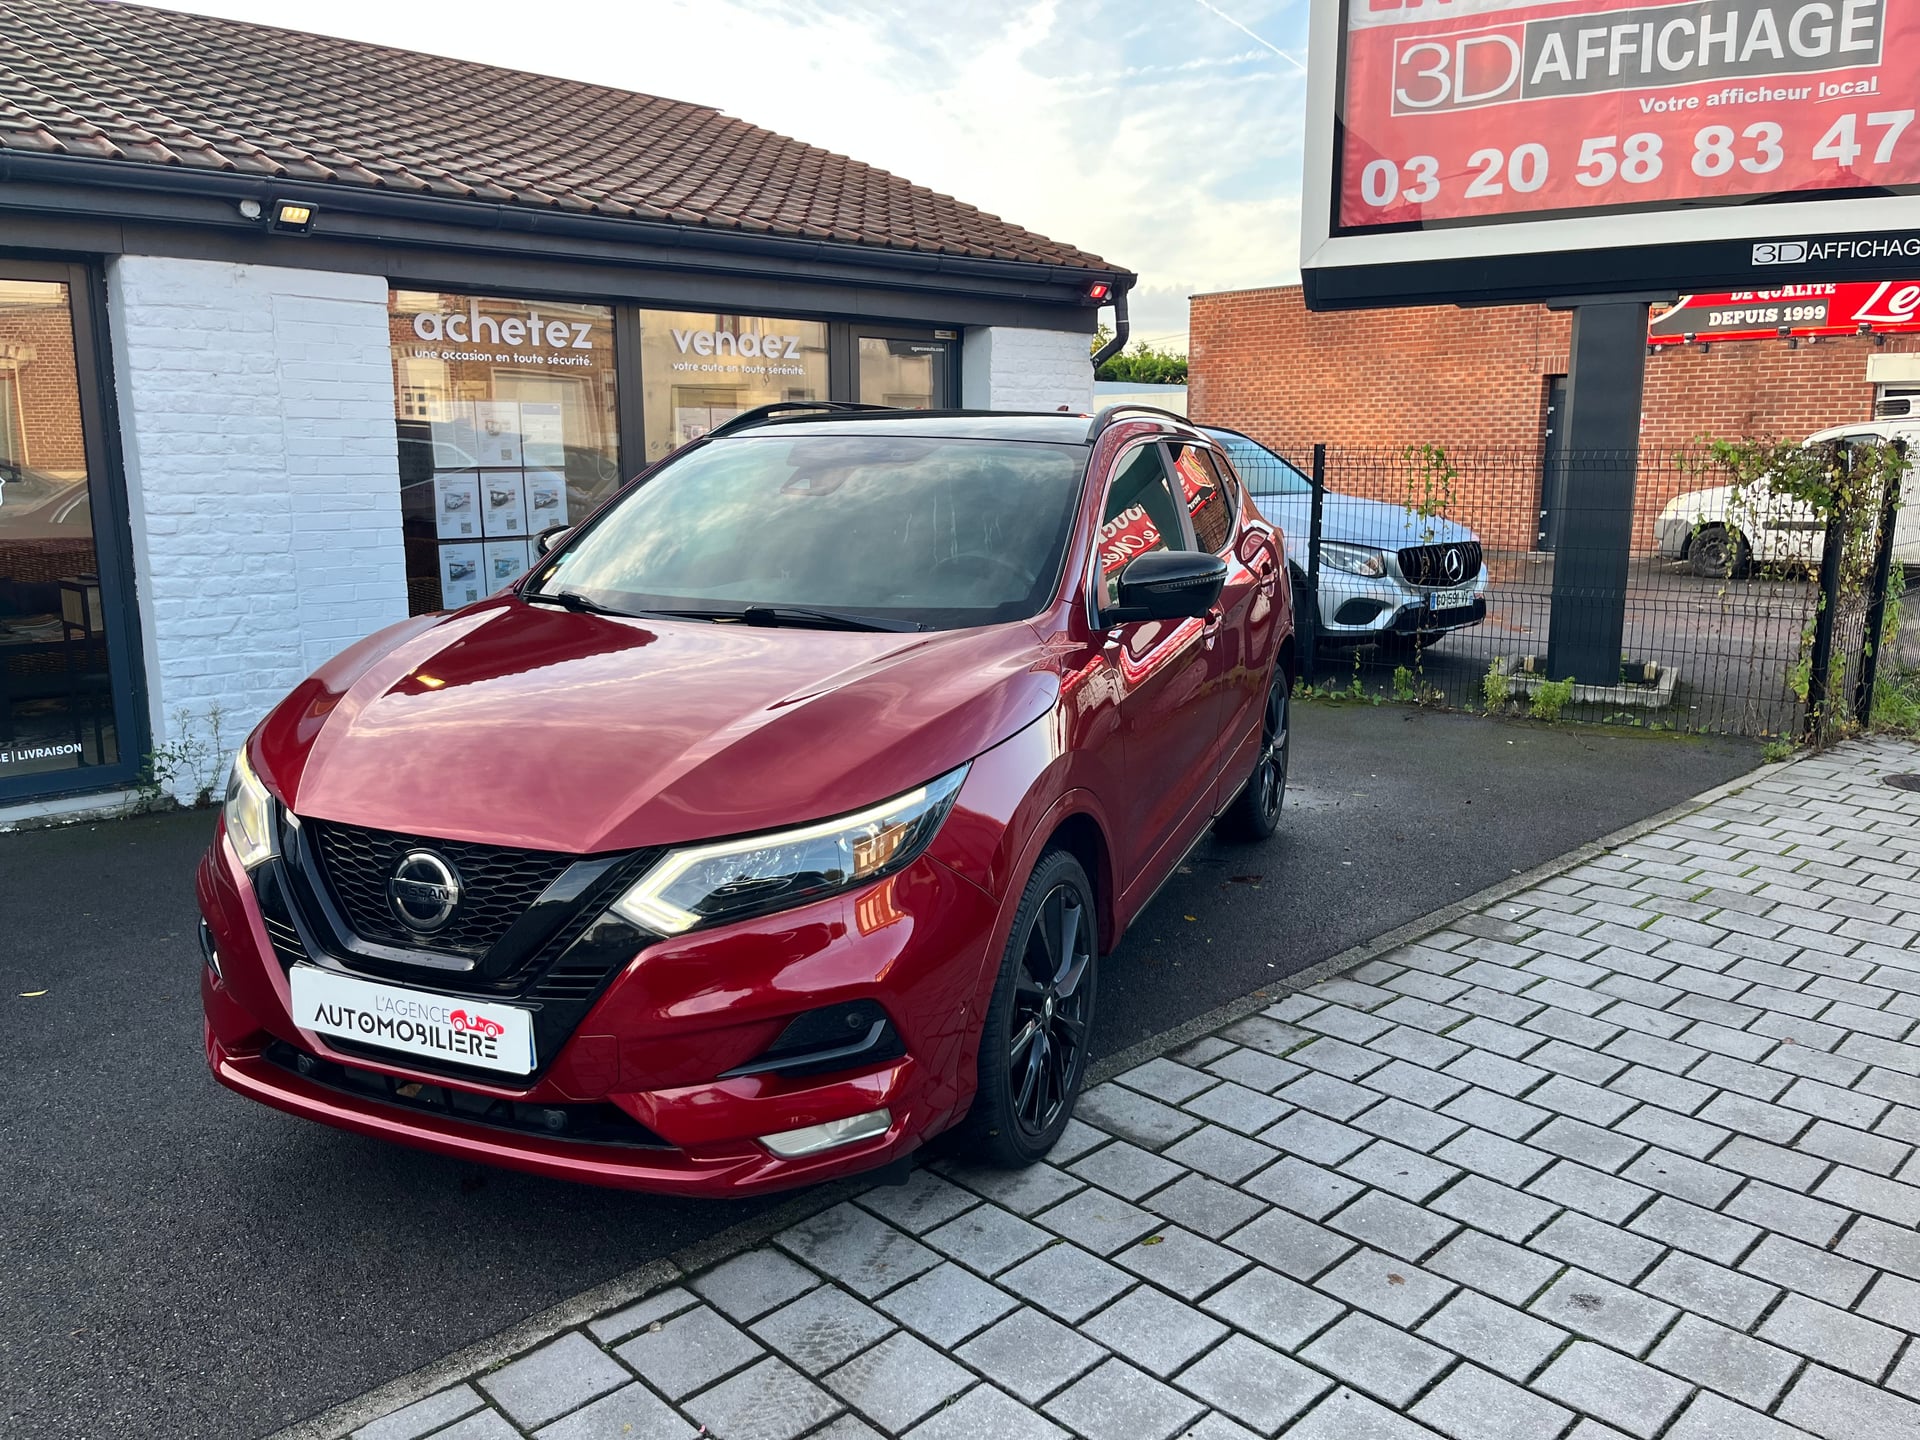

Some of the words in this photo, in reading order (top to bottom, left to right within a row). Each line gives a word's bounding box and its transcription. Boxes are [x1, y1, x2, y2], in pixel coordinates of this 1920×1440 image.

[1395, 34, 1521, 108] 3D
[1529, 0, 1878, 85] AFFICHAGE
[1638, 97, 1700, 114] Votre
[1706, 86, 1812, 107] afficheur
[1817, 76, 1878, 98] local
[1360, 155, 1441, 207] 03
[1463, 142, 1549, 199] 20
[1574, 131, 1664, 188] 58
[1690, 121, 1784, 178] 83
[1811, 109, 1916, 167] 47
[1753, 243, 1806, 264] 3D
[413, 301, 593, 349] achetez
[1708, 308, 1779, 327] DEPUIS
[1782, 305, 1826, 322] 1999
[671, 320, 801, 359] vendez
[414, 349, 438, 359] une
[441, 350, 492, 363] occasion
[495, 354, 510, 363] en
[513, 353, 544, 365] toute
[547, 352, 593, 367] sécurité.
[672, 362, 699, 372] votre
[700, 362, 724, 373] auto
[726, 364, 739, 373] en
[741, 364, 766, 375] toute
[767, 363, 806, 376] sérénité.
[17, 743, 82, 761] LIVRAISON
[375, 995, 451, 1025] L'AGENCE
